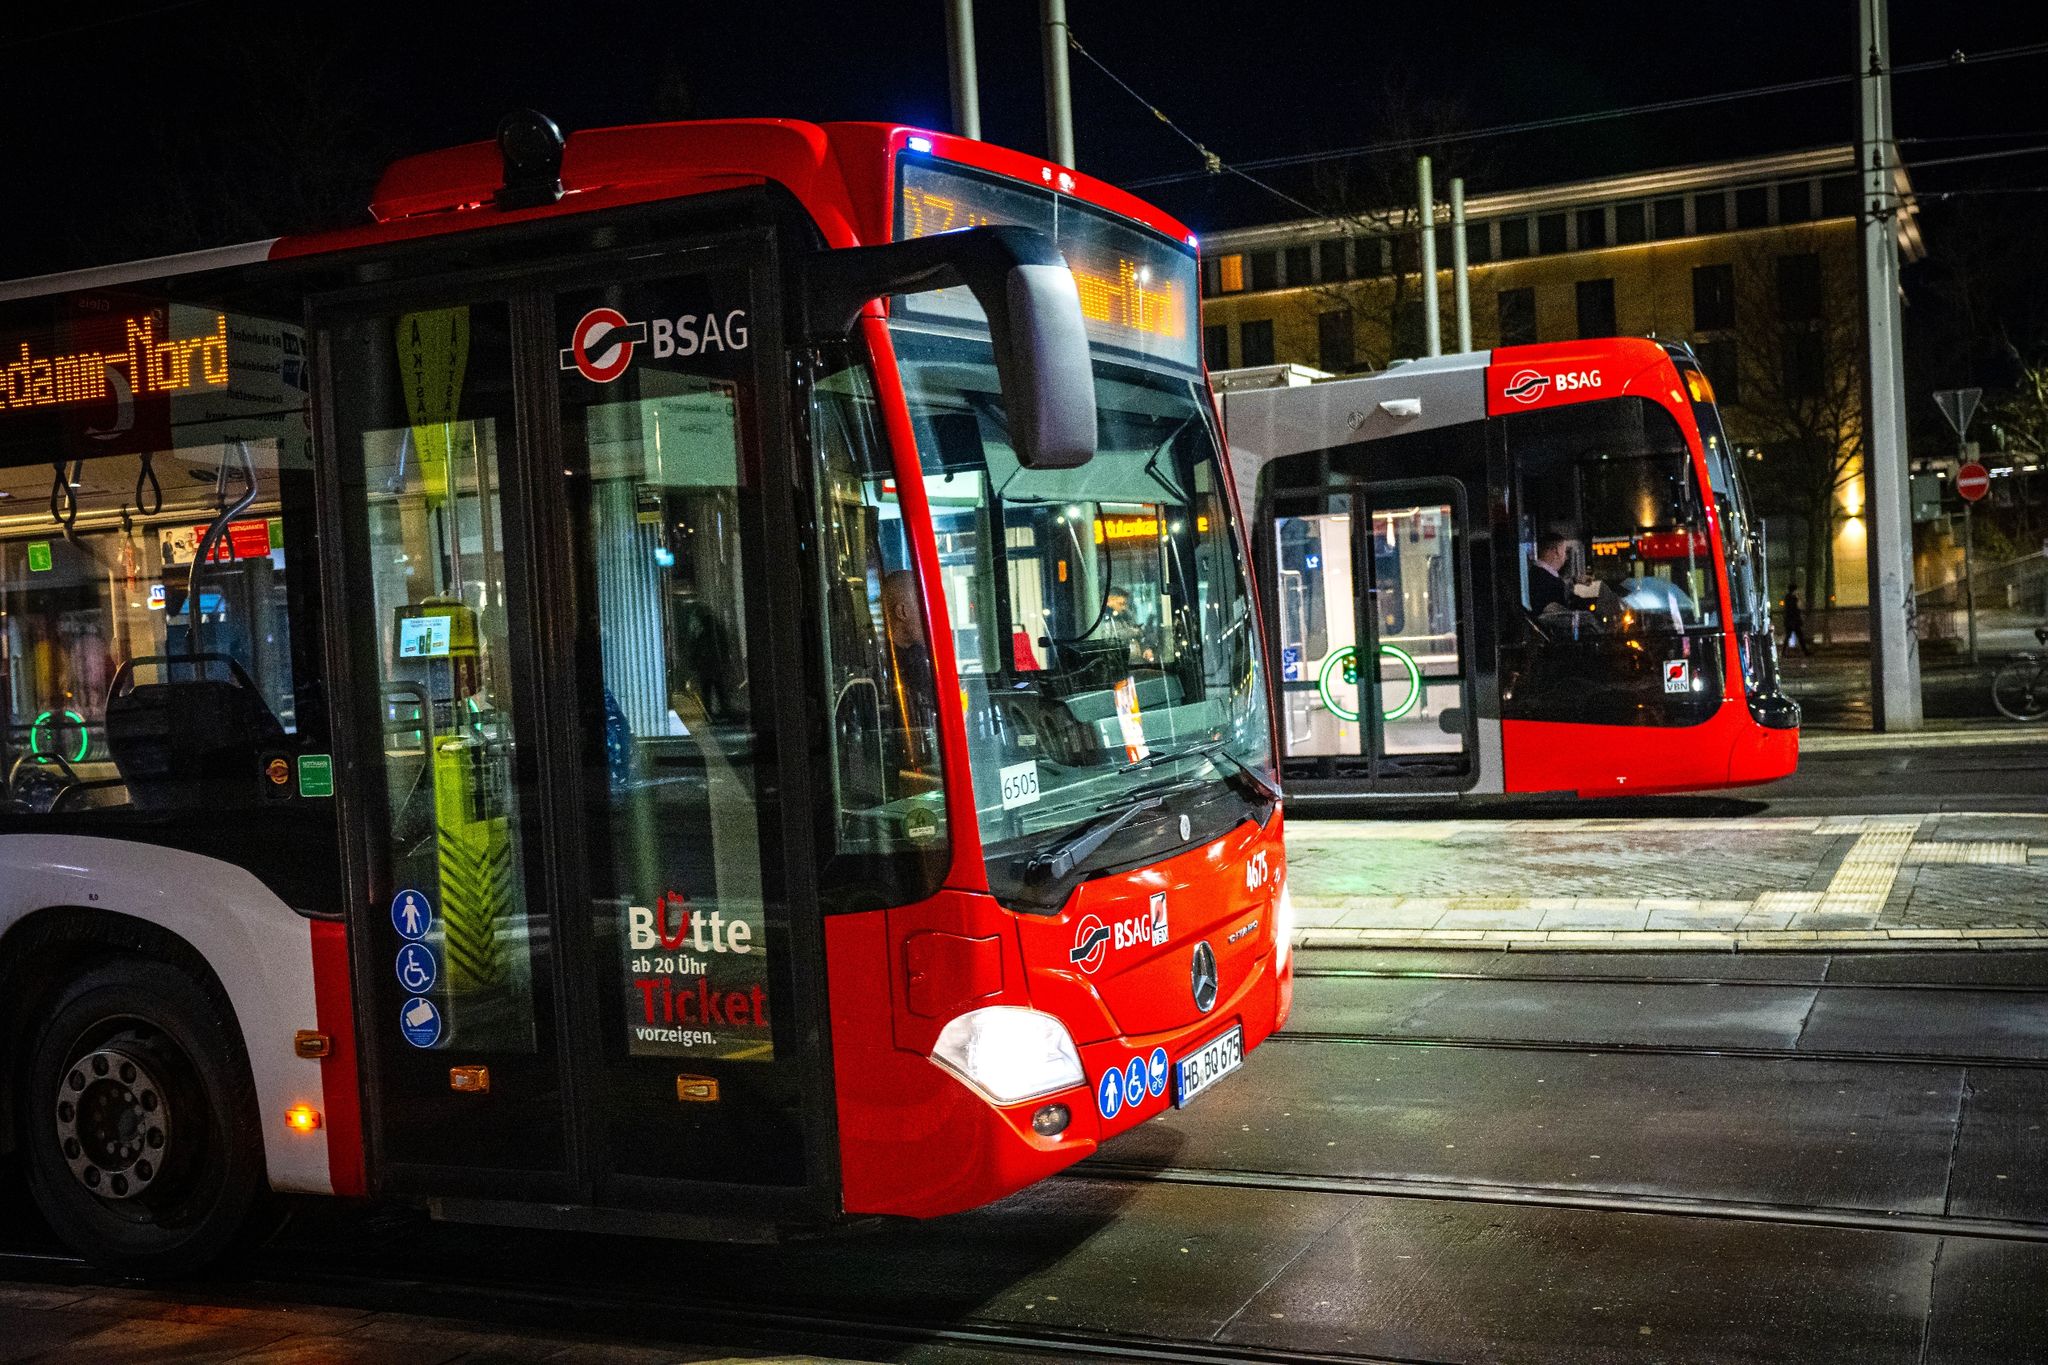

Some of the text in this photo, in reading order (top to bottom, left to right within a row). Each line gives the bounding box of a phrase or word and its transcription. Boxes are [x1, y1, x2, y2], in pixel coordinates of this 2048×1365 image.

[652, 309, 749, 360] BSAG
[1555, 369, 1602, 392] BSAG
[1003, 771, 1037, 800] 6505
[1114, 914, 1150, 951] BSAG
[632, 954, 708, 975] ab 20 Ühr
[634, 975, 768, 1028] Ticket
[636, 1026, 718, 1048] vorzeigen.
[1183, 1060, 1200, 1095] HB
[1204, 1047, 1219, 1080] BQ
[1220, 1034, 1240, 1069] 675
